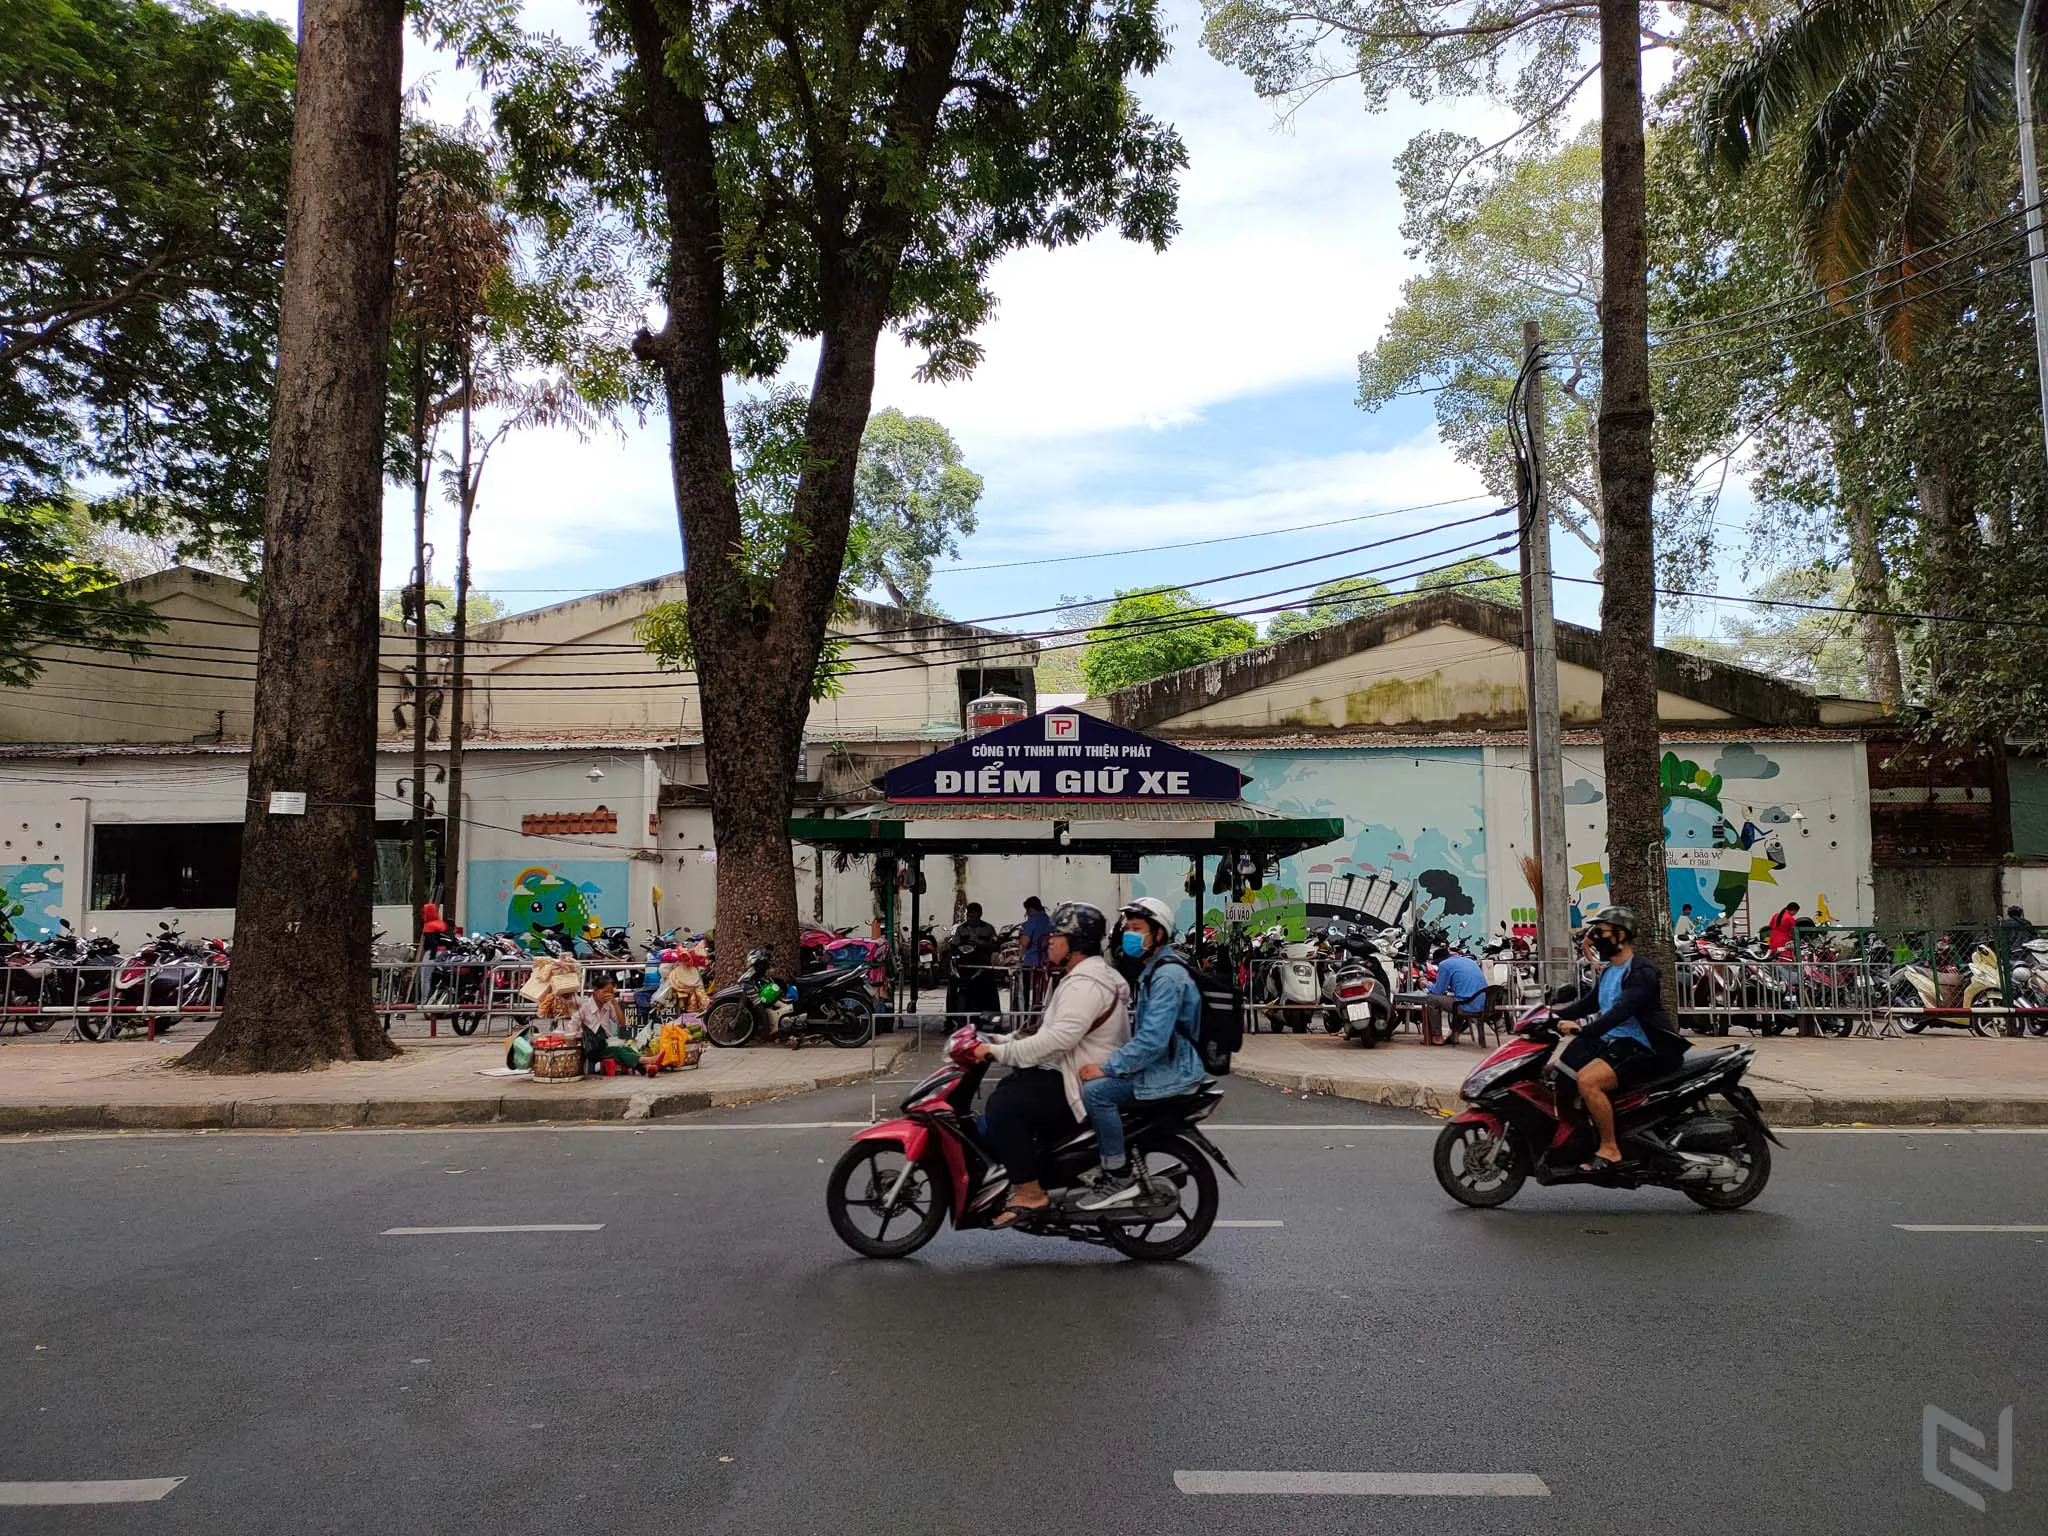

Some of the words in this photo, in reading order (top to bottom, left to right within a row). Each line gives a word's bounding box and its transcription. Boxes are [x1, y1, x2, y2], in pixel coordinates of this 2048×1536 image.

[1051, 719, 1073, 736] TP
[972, 744, 1004, 757] CÔNG
[1007, 746, 1021, 757] TY
[1024, 745, 1054, 757] TNHH
[1057, 745, 1082, 757] MTV
[1085, 744, 1119, 760] THIỆN
[1122, 744, 1152, 758] PHÁT
[935, 761, 1041, 794] ĐIỂM
[1055, 766, 1129, 794] GIỮ
[1137, 771, 1190, 795] XE
